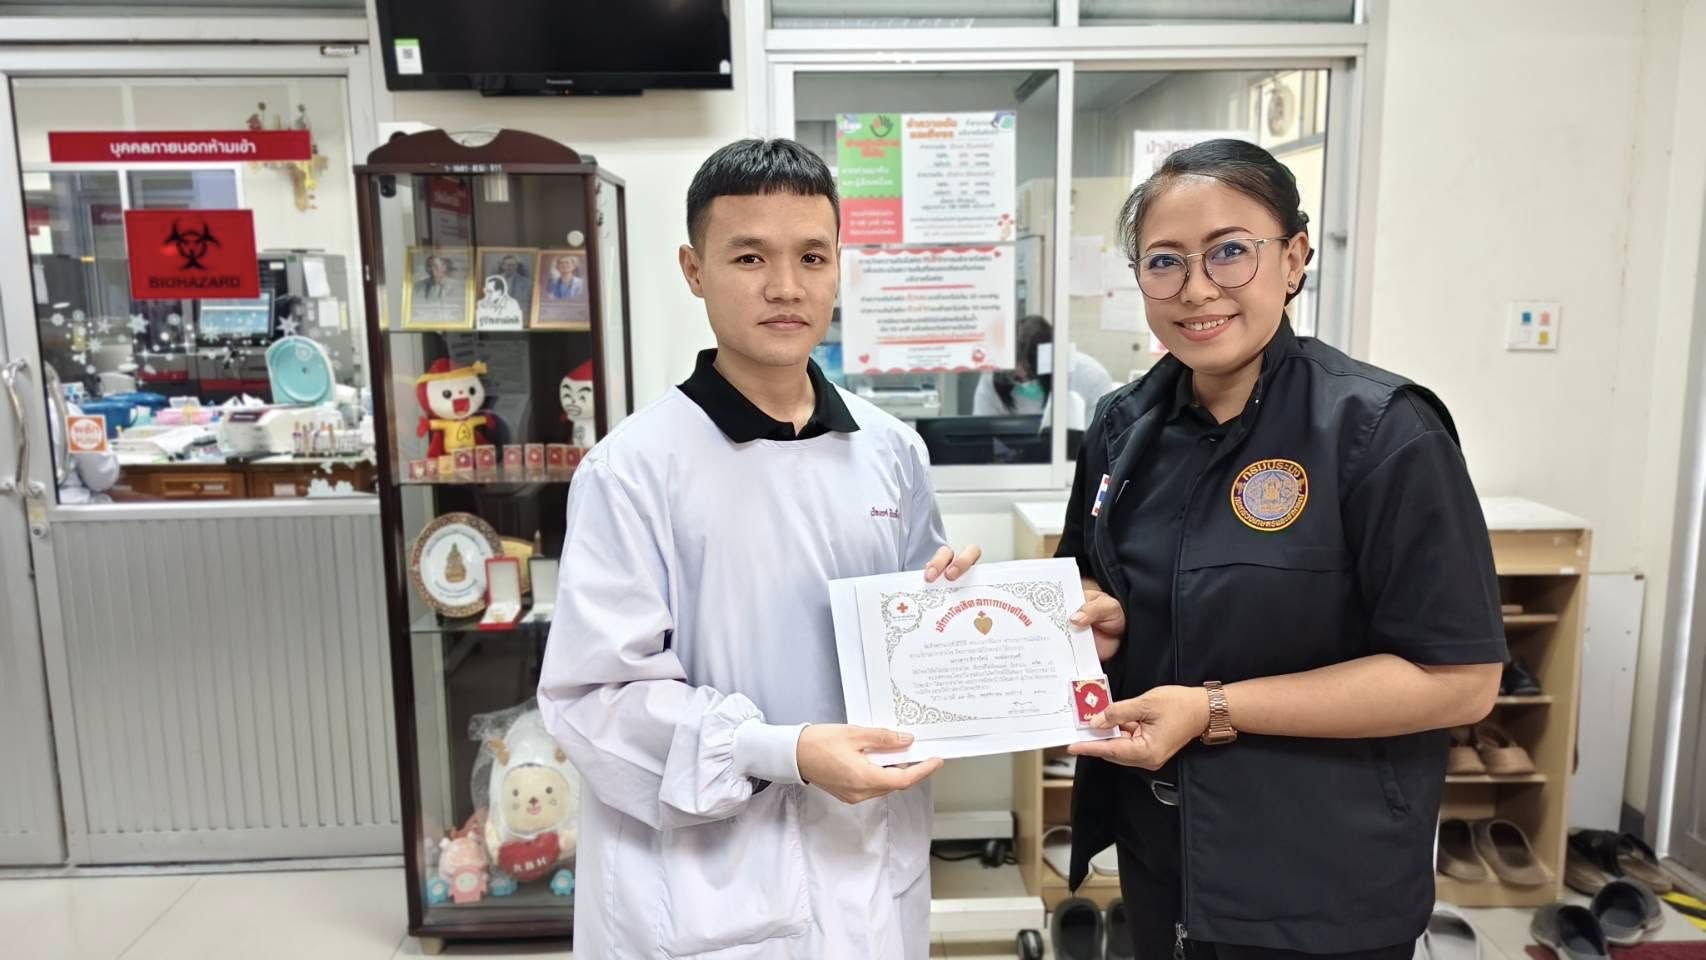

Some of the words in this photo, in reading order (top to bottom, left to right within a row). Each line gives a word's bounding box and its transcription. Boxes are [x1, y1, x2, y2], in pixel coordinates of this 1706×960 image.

[109, 138, 257, 159] บุคคลภายนอกห้ามเข้า
[148, 276, 241, 289] BIOHAZARD
[1242, 461, 1301, 481] กรมประมง
